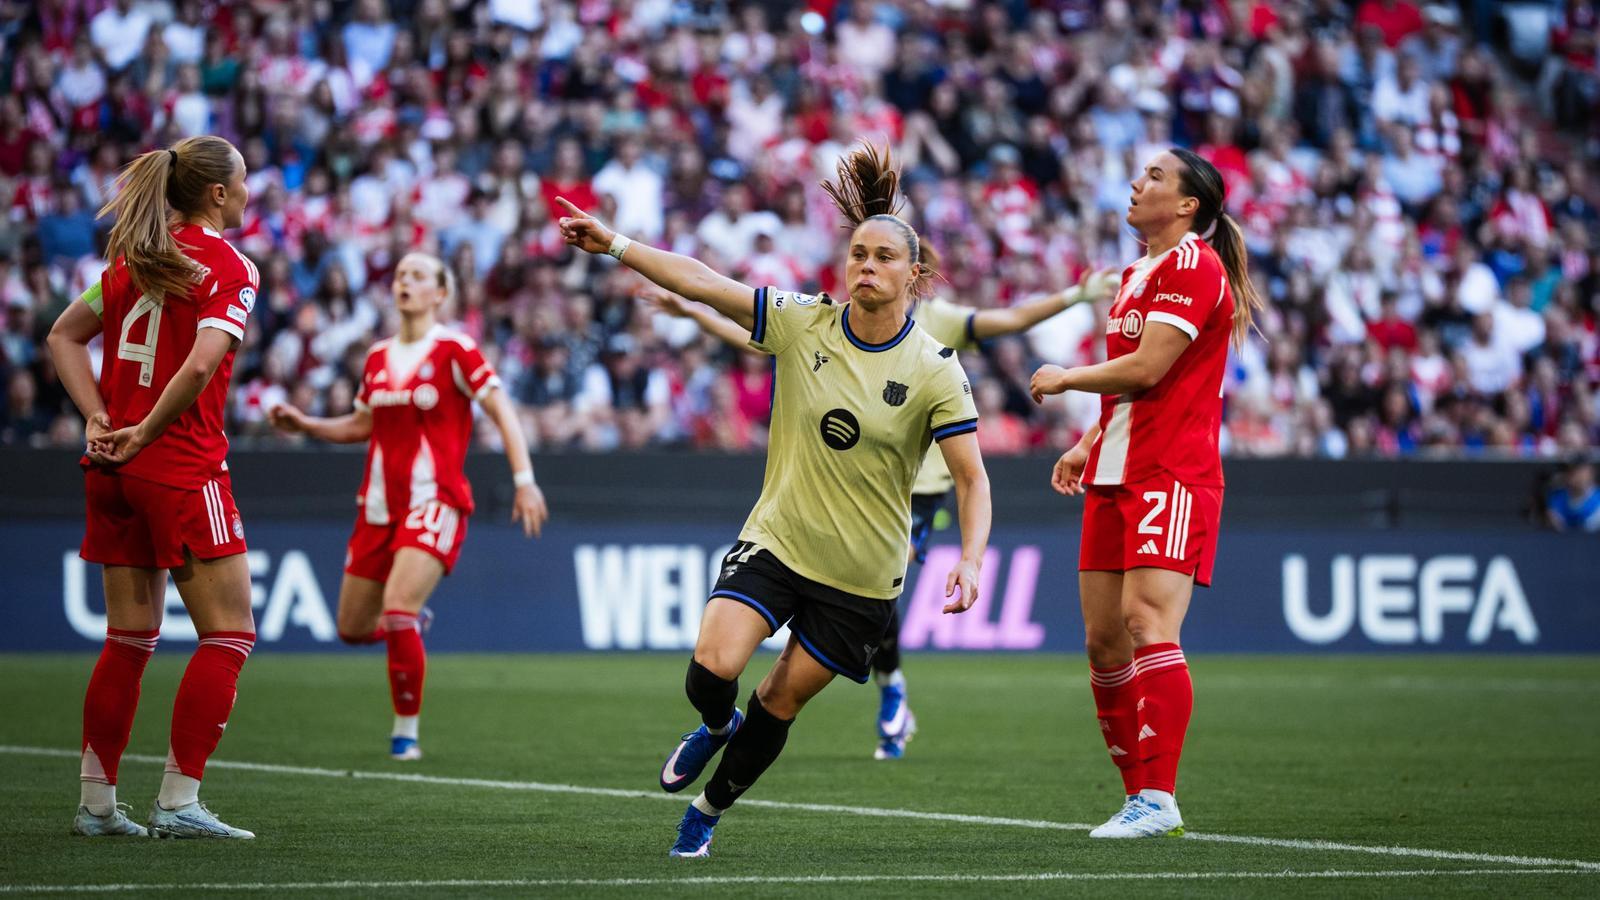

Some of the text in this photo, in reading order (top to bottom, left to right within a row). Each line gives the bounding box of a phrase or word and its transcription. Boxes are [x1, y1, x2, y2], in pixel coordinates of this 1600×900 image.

[1153, 292, 1194, 307] ITACHI
[118, 291, 165, 388] 4
[405, 500, 447, 534] 20
[1137, 491, 1168, 535] 2
[573, 544, 1046, 650] WEL ALL
[1282, 553, 1541, 645] UEFA
